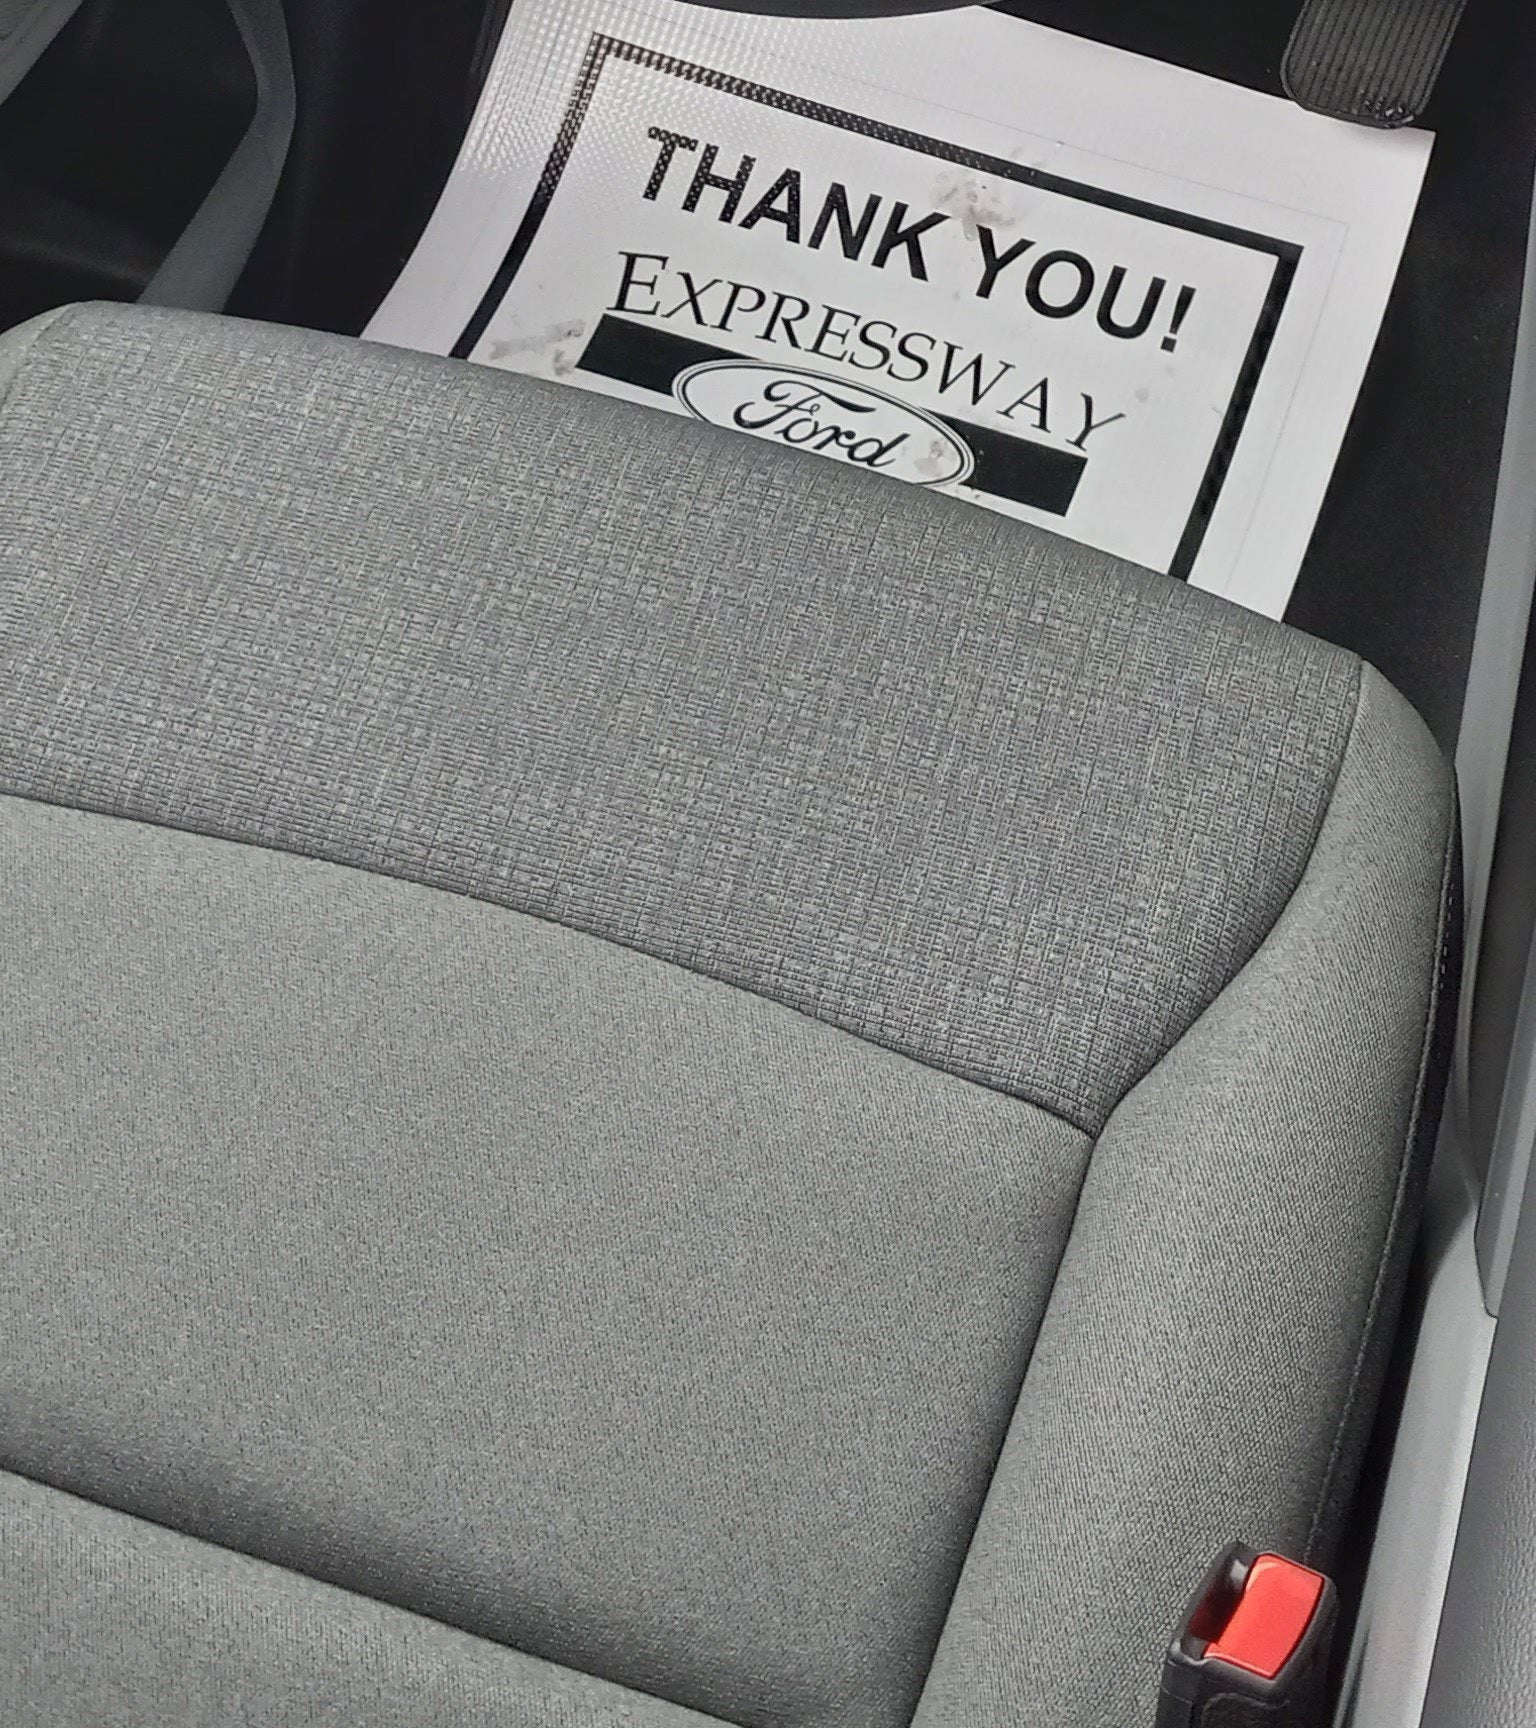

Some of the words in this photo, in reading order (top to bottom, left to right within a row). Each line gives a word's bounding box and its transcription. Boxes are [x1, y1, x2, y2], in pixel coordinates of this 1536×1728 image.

[642, 125, 954, 284] THANK
[970, 220, 1197, 354] YOU!
[606, 249, 1126, 454] EXPRESSWAY
[732, 376, 913, 473] Ford
